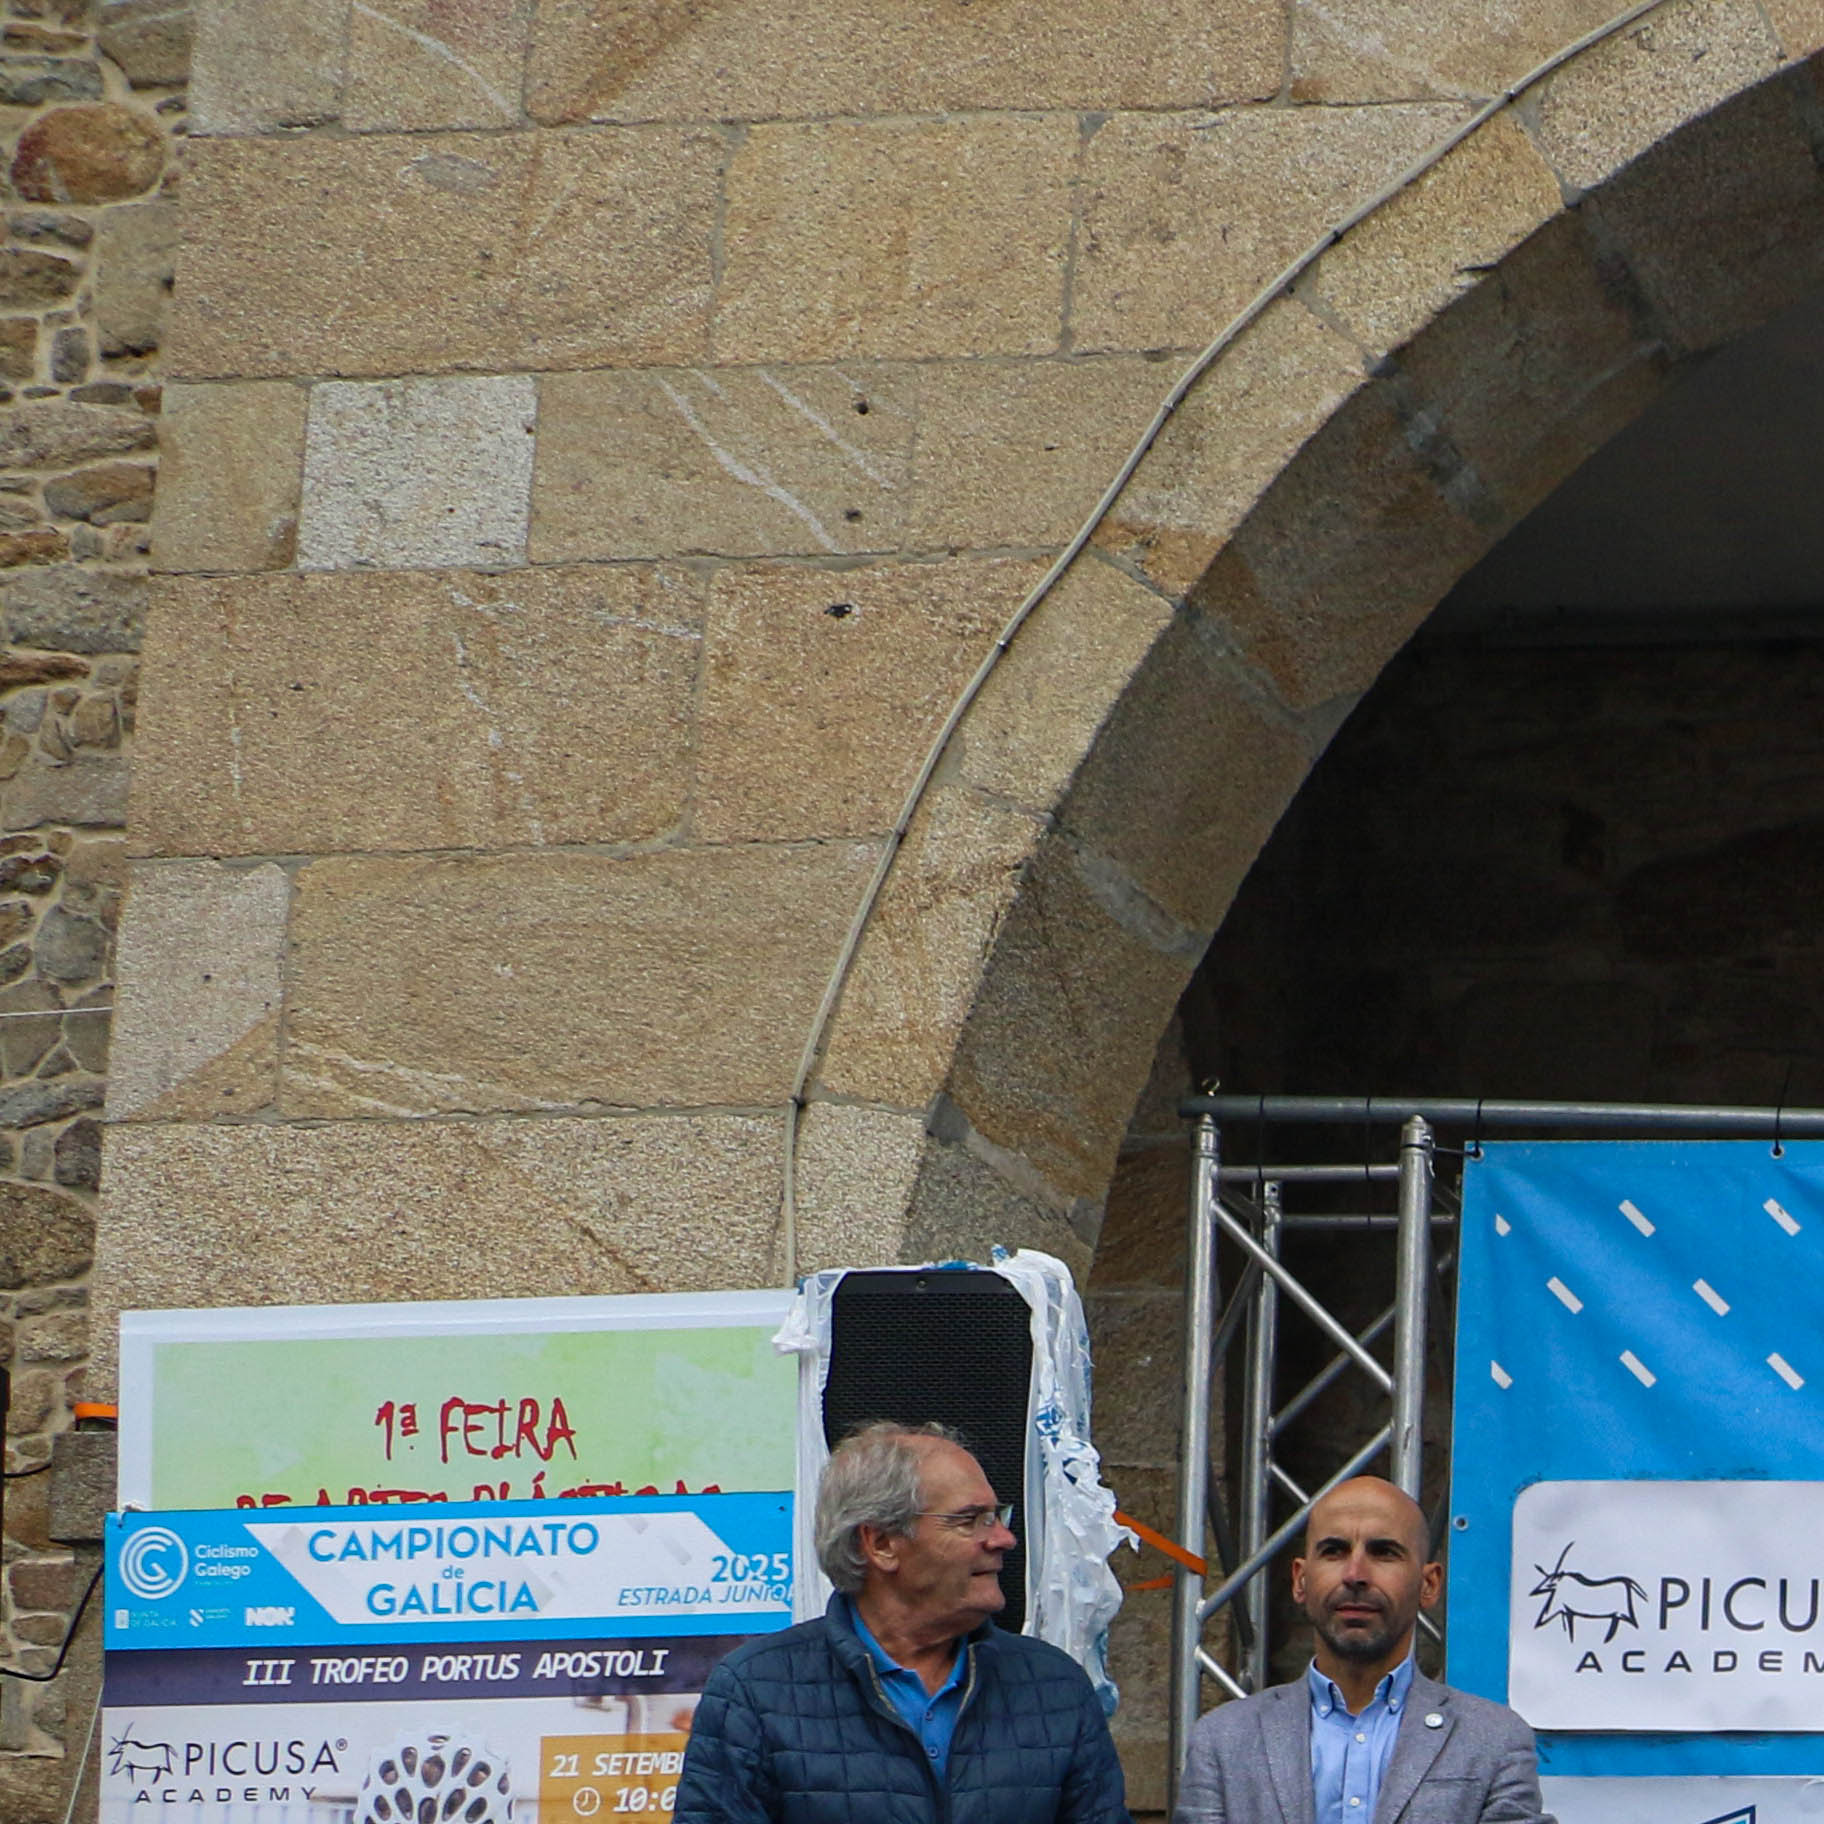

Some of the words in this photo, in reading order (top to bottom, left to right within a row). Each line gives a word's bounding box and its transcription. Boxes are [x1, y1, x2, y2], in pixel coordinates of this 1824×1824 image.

[441, 1397, 577, 1463] FEIRA
[195, 1545, 259, 1558] Ciclismo
[308, 1522, 598, 1562] CAMPIONATO
[194, 1563, 251, 1579] Galego
[442, 1564, 464, 1579] de
[711, 1553, 789, 1582] 2025
[366, 1581, 539, 1616] GALICIA
[618, 1587, 712, 1606] ESTRADA
[243, 1660, 294, 1686] III
[310, 1658, 408, 1685] TROFEO
[421, 1654, 520, 1682] PORTUS
[533, 1649, 668, 1679] APOSTOLI
[550, 1754, 579, 1777] 21
[135, 1788, 317, 1803] ACADEMY
